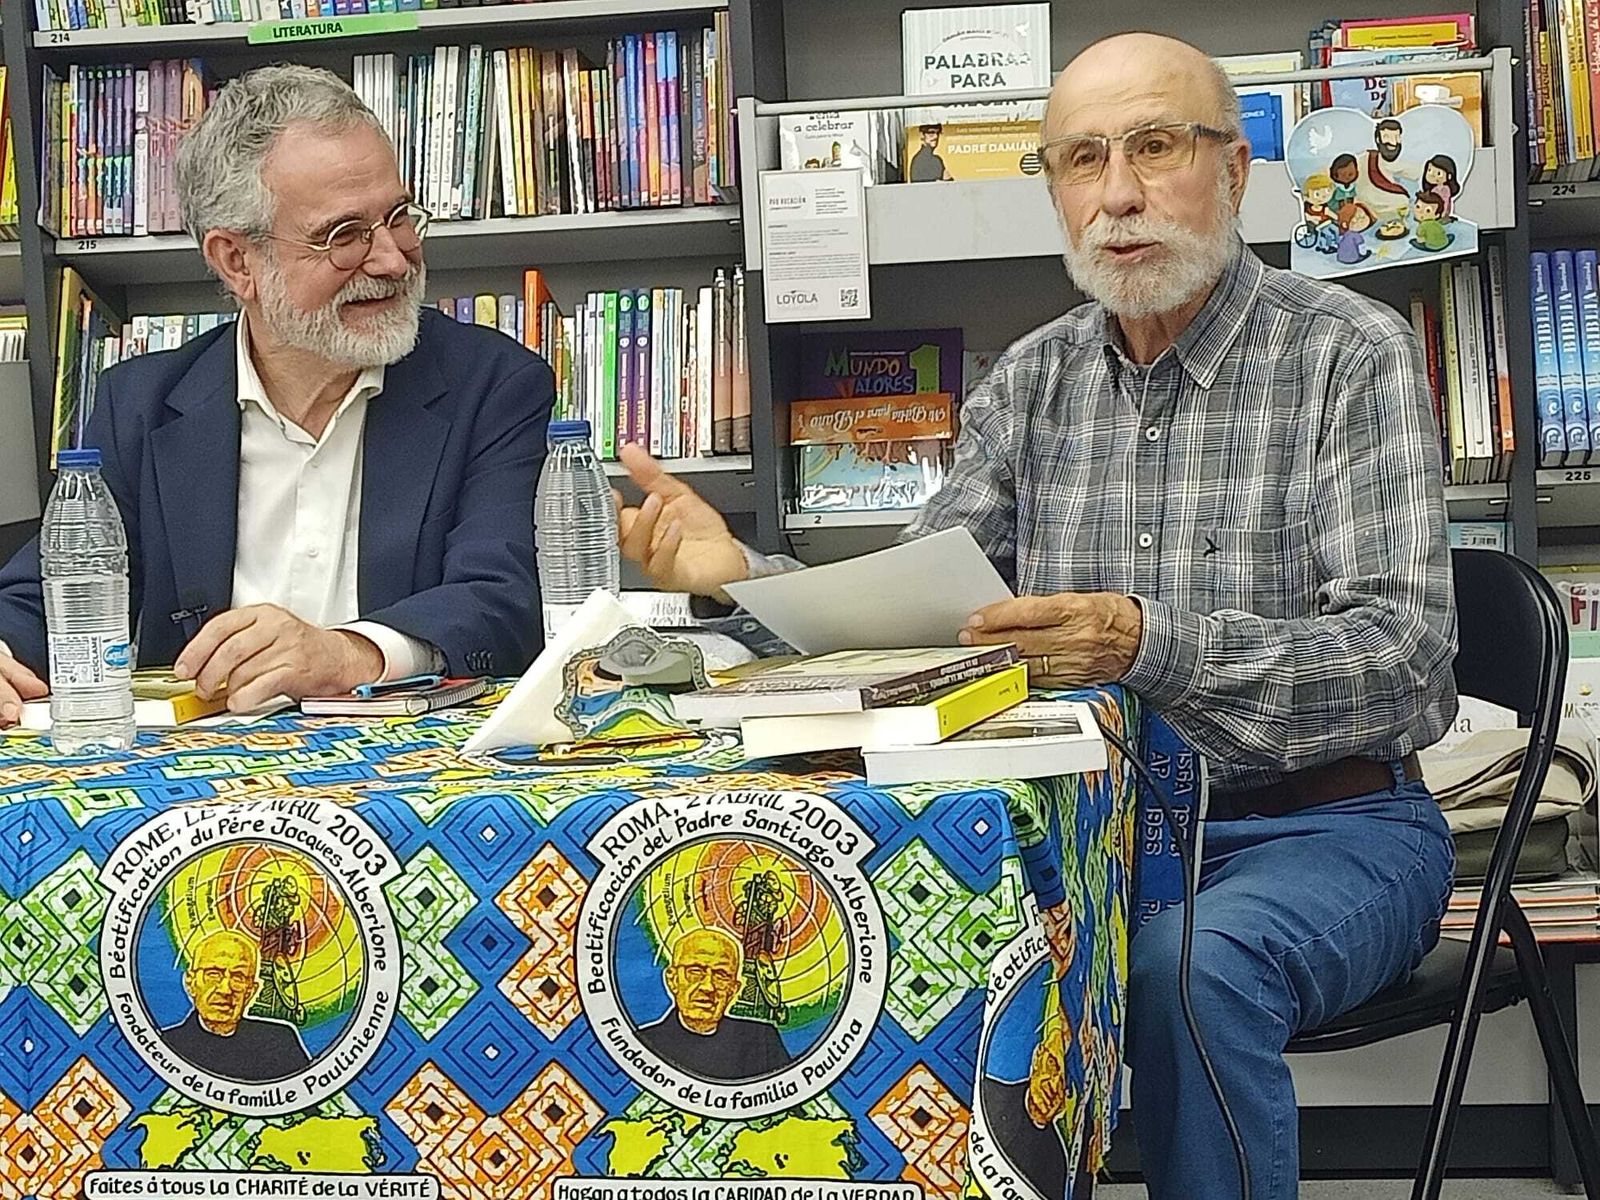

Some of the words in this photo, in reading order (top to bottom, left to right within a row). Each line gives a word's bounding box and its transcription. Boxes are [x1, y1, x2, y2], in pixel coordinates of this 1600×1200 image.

[50, 33, 70, 44] 214
[272, 22, 343, 39] LITERATURA
[951, 72, 1006, 88] PARA
[805, 120, 854, 131] celebrar
[948, 143, 986, 154] PADRE
[989, 140, 1037, 153] DAMIÁN
[1552, 185, 1576, 195] 224
[78, 240, 97, 250] 215
[776, 292, 818, 305] LOYOLA
[1535, 293, 1552, 353] BIBLIA
[1558, 293, 1576, 353] BIBLIA
[1583, 292, 1600, 352] BIBLIA
[824, 346, 900, 377] MUNDO
[910, 344, 940, 395] 1
[836, 376, 914, 398] VALORES
[810, 409, 854, 434] Baño
[854, 409, 865, 425] el
[866, 403, 891, 420] para
[891, 405, 927, 424] Biblia
[814, 516, 822, 524] 2
[600, 802, 681, 860] ROMA,
[788, 800, 859, 857] 2003
[112, 822, 182, 885] ROME,
[327, 814, 387, 876] 2003
[109, 845, 183, 979] Béatification
[190, 824, 214, 848] du
[270, 816, 343, 868] Jacques
[339, 866, 387, 972] Alberione
[584, 853, 643, 995] Beatificación
[642, 831, 673, 858] del
[674, 809, 733, 837] Padre
[741, 809, 835, 869] Santiago
[832, 872, 873, 984] Alberione
[116, 991, 182, 1075] Fondateur
[182, 1074, 205, 1092] de
[205, 1084, 226, 1102] la
[226, 1088, 298, 1108] famille
[303, 990, 390, 1096] Paulinienne
[600, 1016, 676, 1090] Fundador
[677, 1084, 701, 1104] de
[703, 1091, 727, 1110] la
[727, 1081, 799, 1112] familia
[801, 1018, 864, 1087] Paulina
[971, 1131, 985, 1155] de
[978, 1153, 999, 1180] la
[89, 1178, 143, 1195] Faites
[160, 1179, 206, 1195] tous
[209, 1178, 230, 1195] la
[235, 1176, 309, 1196] CHARITÉ
[312, 1180, 335, 1197] de
[338, 1180, 359, 1197] la
[364, 1176, 431, 1198] VÉRITÉ
[558, 1184, 614, 1200] Hagan
[617, 1188, 630, 1200] a
[630, 1185, 688, 1200] todos
[691, 1186, 711, 1200] la
[714, 1185, 788, 1200] CARIDAD
[791, 1186, 814, 1200] de
[817, 1187, 839, 1200] la
[842, 1188, 915, 1200] VERDAD
